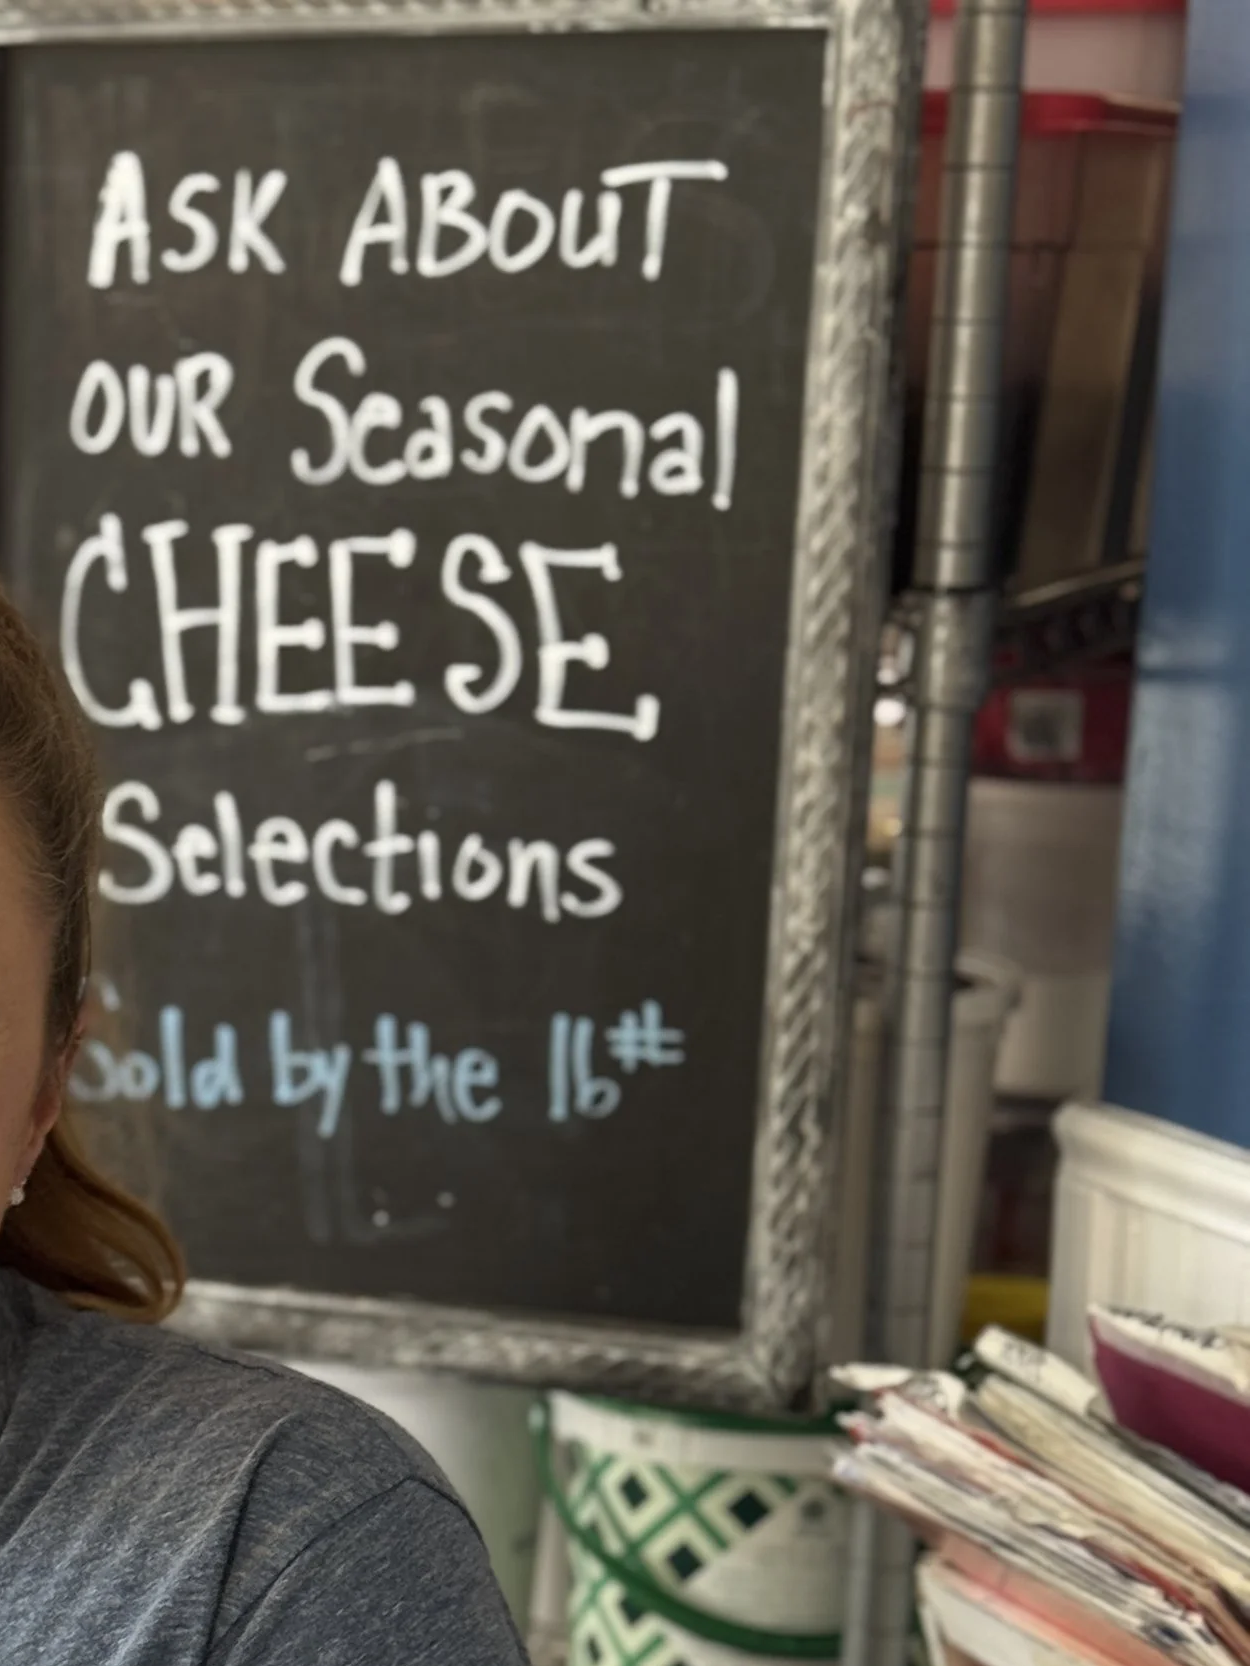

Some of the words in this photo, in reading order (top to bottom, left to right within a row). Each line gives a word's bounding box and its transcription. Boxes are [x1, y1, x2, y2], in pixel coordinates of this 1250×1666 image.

[86, 149, 288, 289] ASK
[69, 351, 234, 459] OUR
[290, 336, 739, 511] Seasonal
[60, 512, 661, 742] CHEESE
[97, 779, 623, 923] Selections
[268, 1009, 352, 1139] by
[363, 1013, 502, 1123] the
